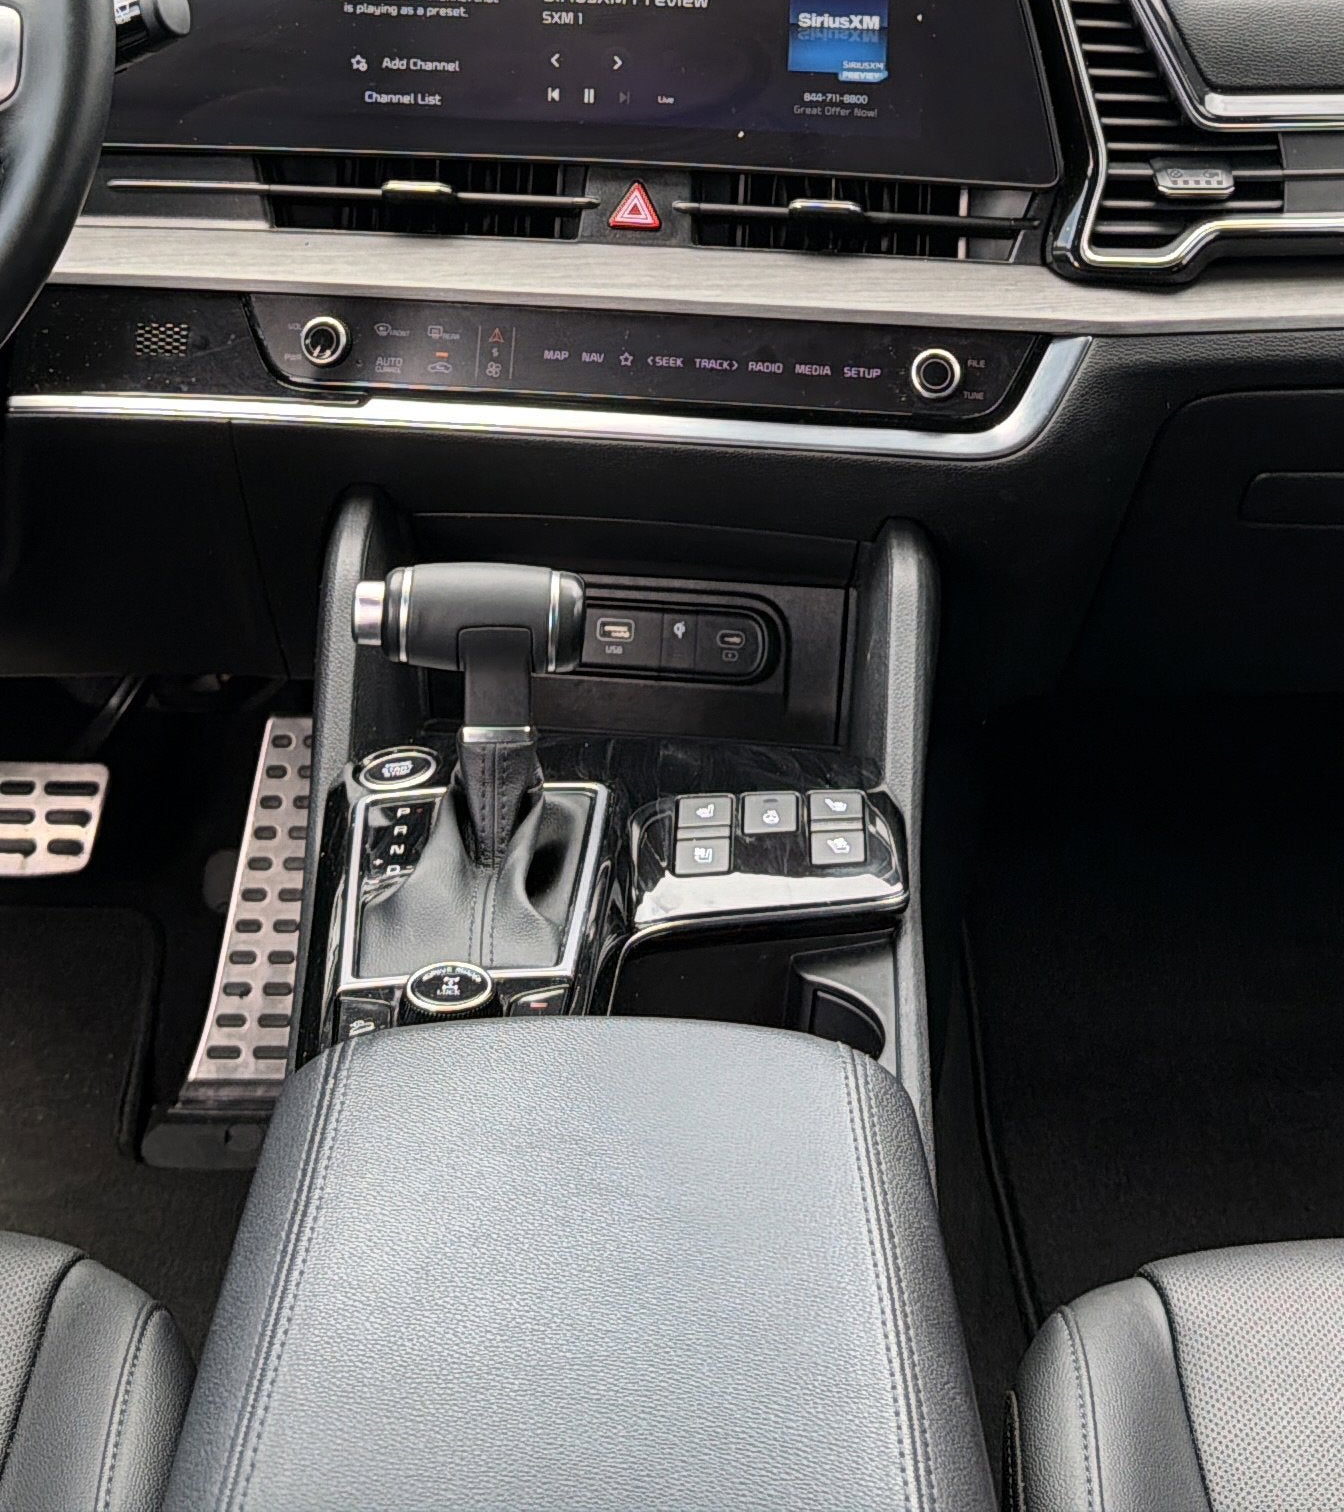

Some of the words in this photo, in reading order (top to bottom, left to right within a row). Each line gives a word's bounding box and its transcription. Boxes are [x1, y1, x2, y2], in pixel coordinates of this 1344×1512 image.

[343, 2, 354, 13] is
[356, 3, 398, 17] playing
[400, 6, 414, 15] as
[416, 6, 425, 15] a
[426, 6, 469, 18] preset.
[542, 11, 574, 25] SXM
[578, 13, 583, 25] 1
[797, 12, 881, 30] SiriusXM
[381, 57, 407, 70] Add
[409, 58, 460, 72] Channel
[364, 90, 415, 104] Channel
[418, 92, 442, 105] List
[793, 104, 822, 116] Great
[824, 106, 852, 117] Offer
[854, 108, 878, 118] Now!
[375, 356, 404, 367] AUTO
[543, 349, 570, 361] MAP
[581, 351, 605, 363] NAV
[655, 356, 684, 368] SEEK
[694, 358, 731, 370] TRACK
[748, 361, 784, 374] RADIO
[795, 364, 832, 376] MEDIA
[843, 366, 882, 379] SETUP
[967, 359, 986, 368] FILE
[963, 391, 984, 400] TUNE
[605, 645, 623, 655] USB
[397, 807, 411, 819] P
[389, 844, 405, 856] N
